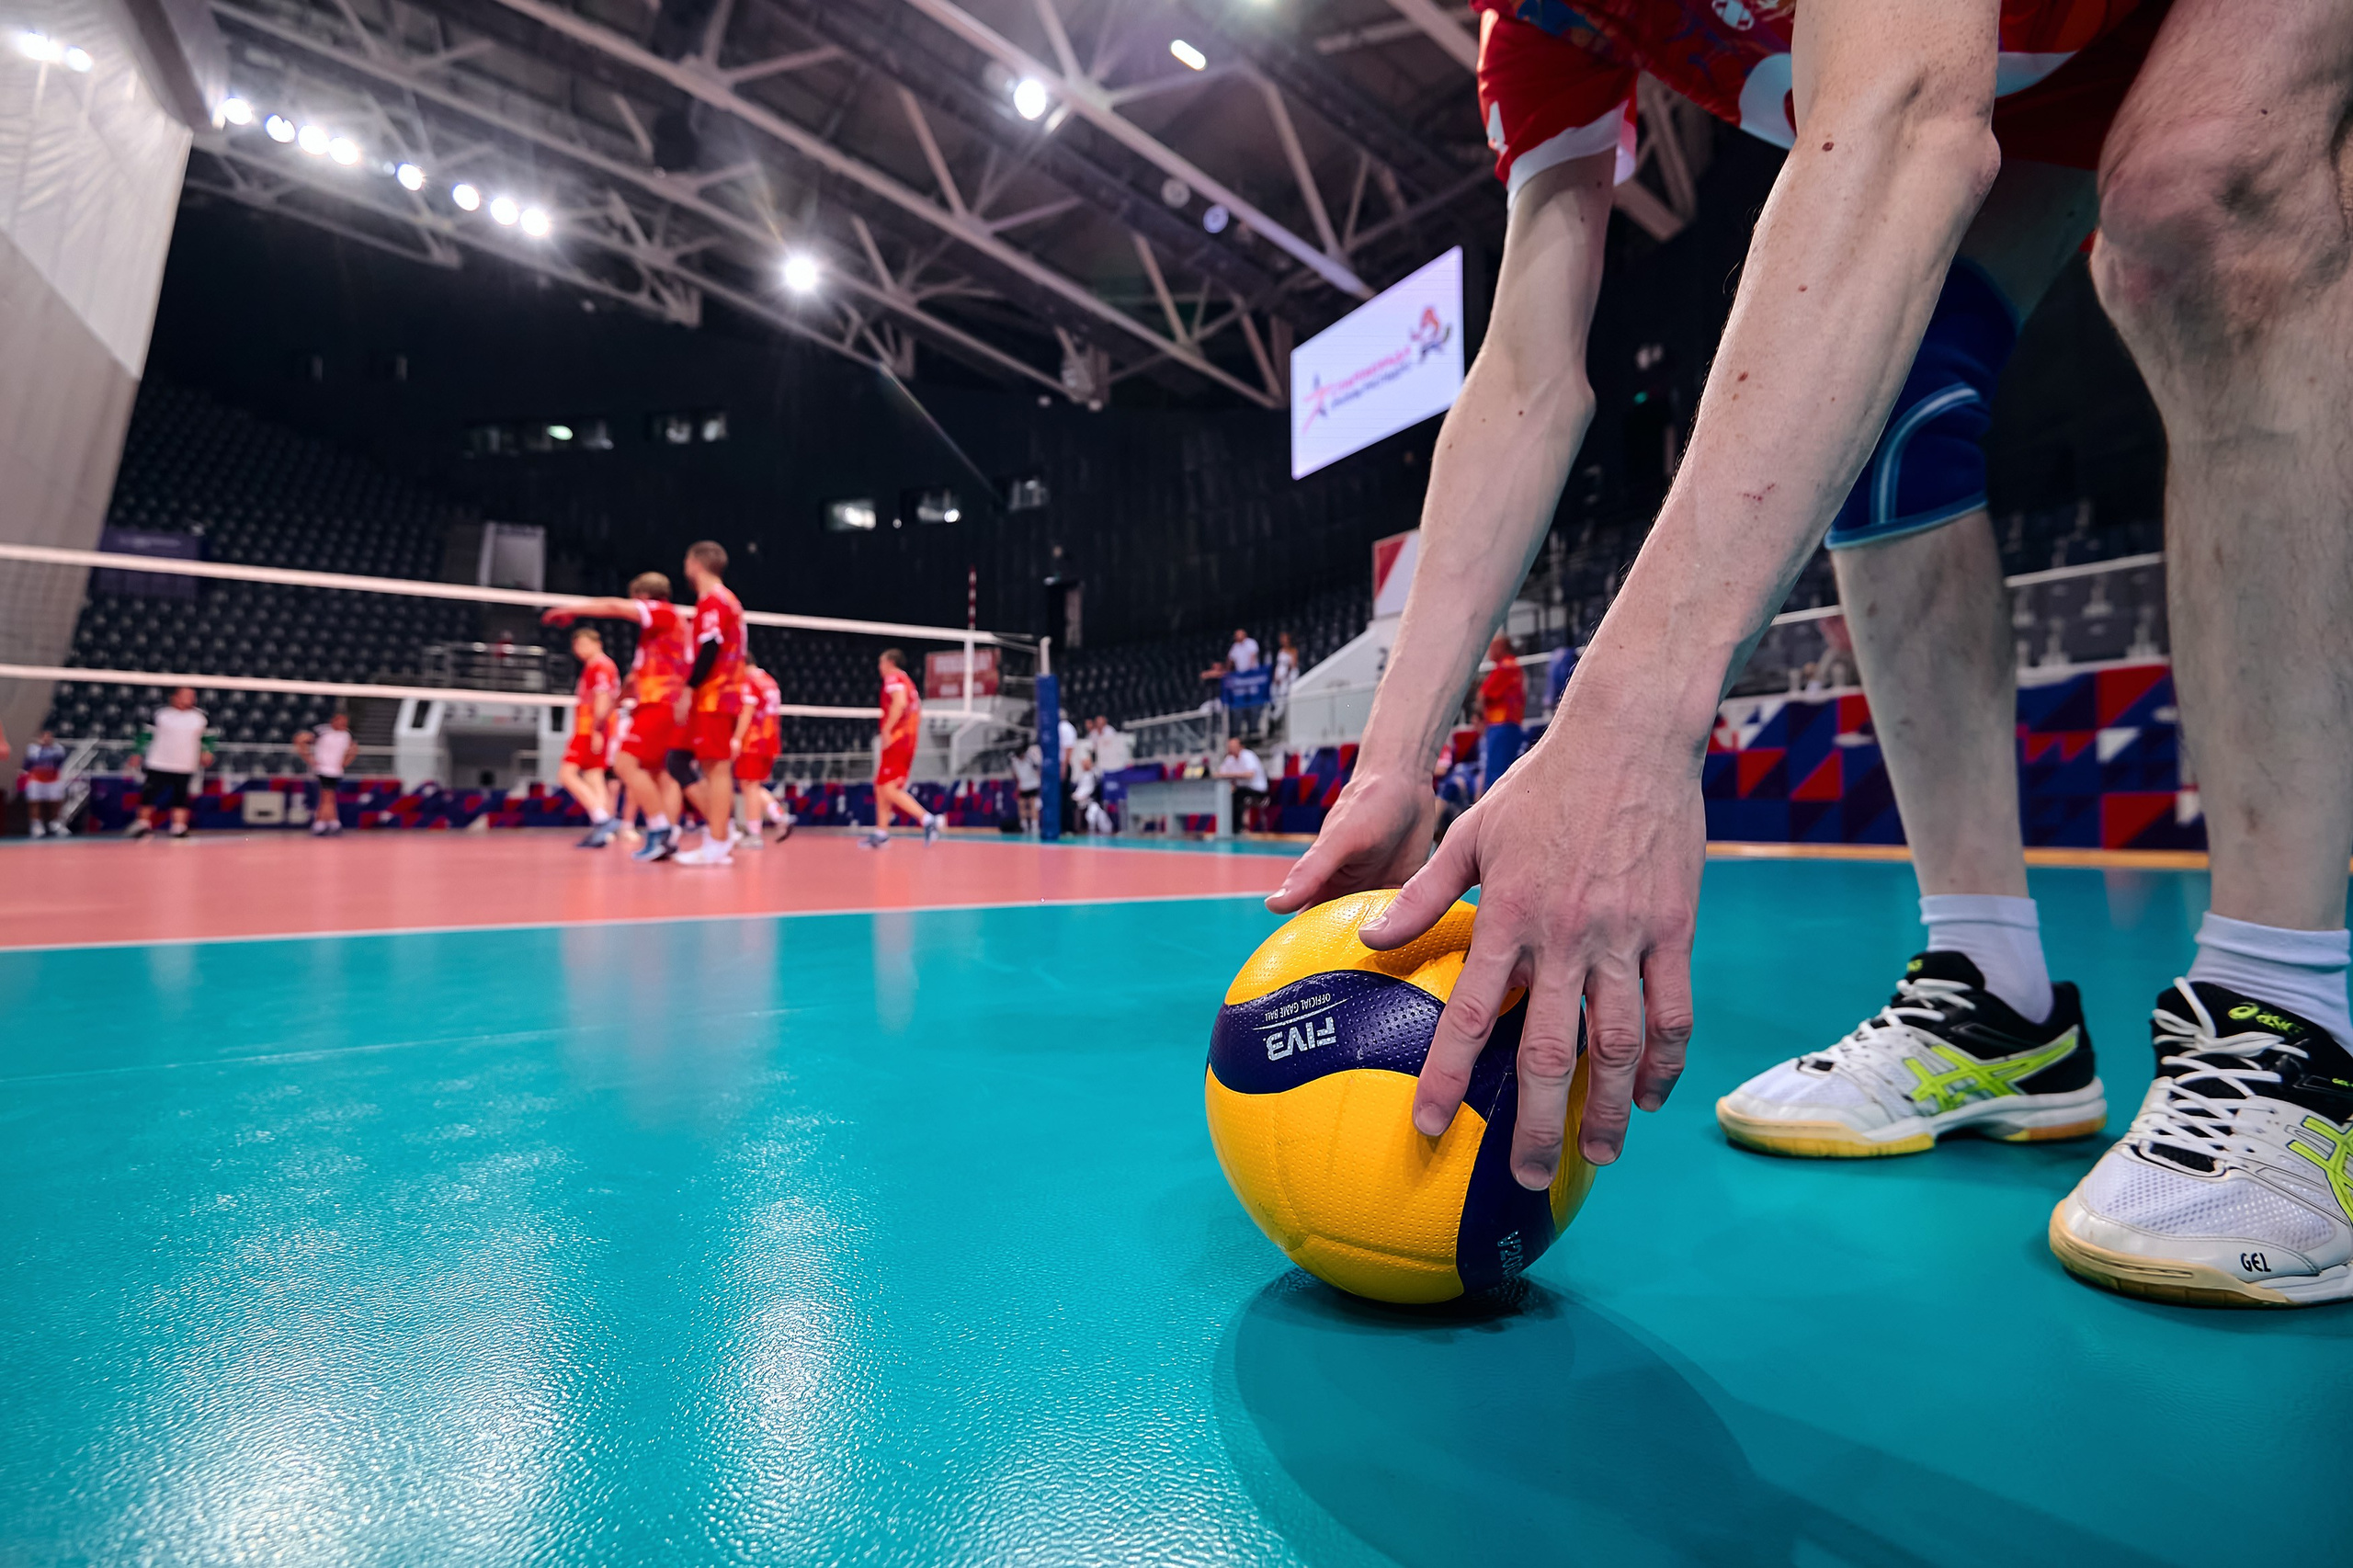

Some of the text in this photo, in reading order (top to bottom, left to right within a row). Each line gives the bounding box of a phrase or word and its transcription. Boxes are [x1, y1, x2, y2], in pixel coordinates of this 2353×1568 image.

[1264, 993, 1331, 1022] OFFICIAL GAME BALL
[2240, 1252, 2272, 1273] GEL
